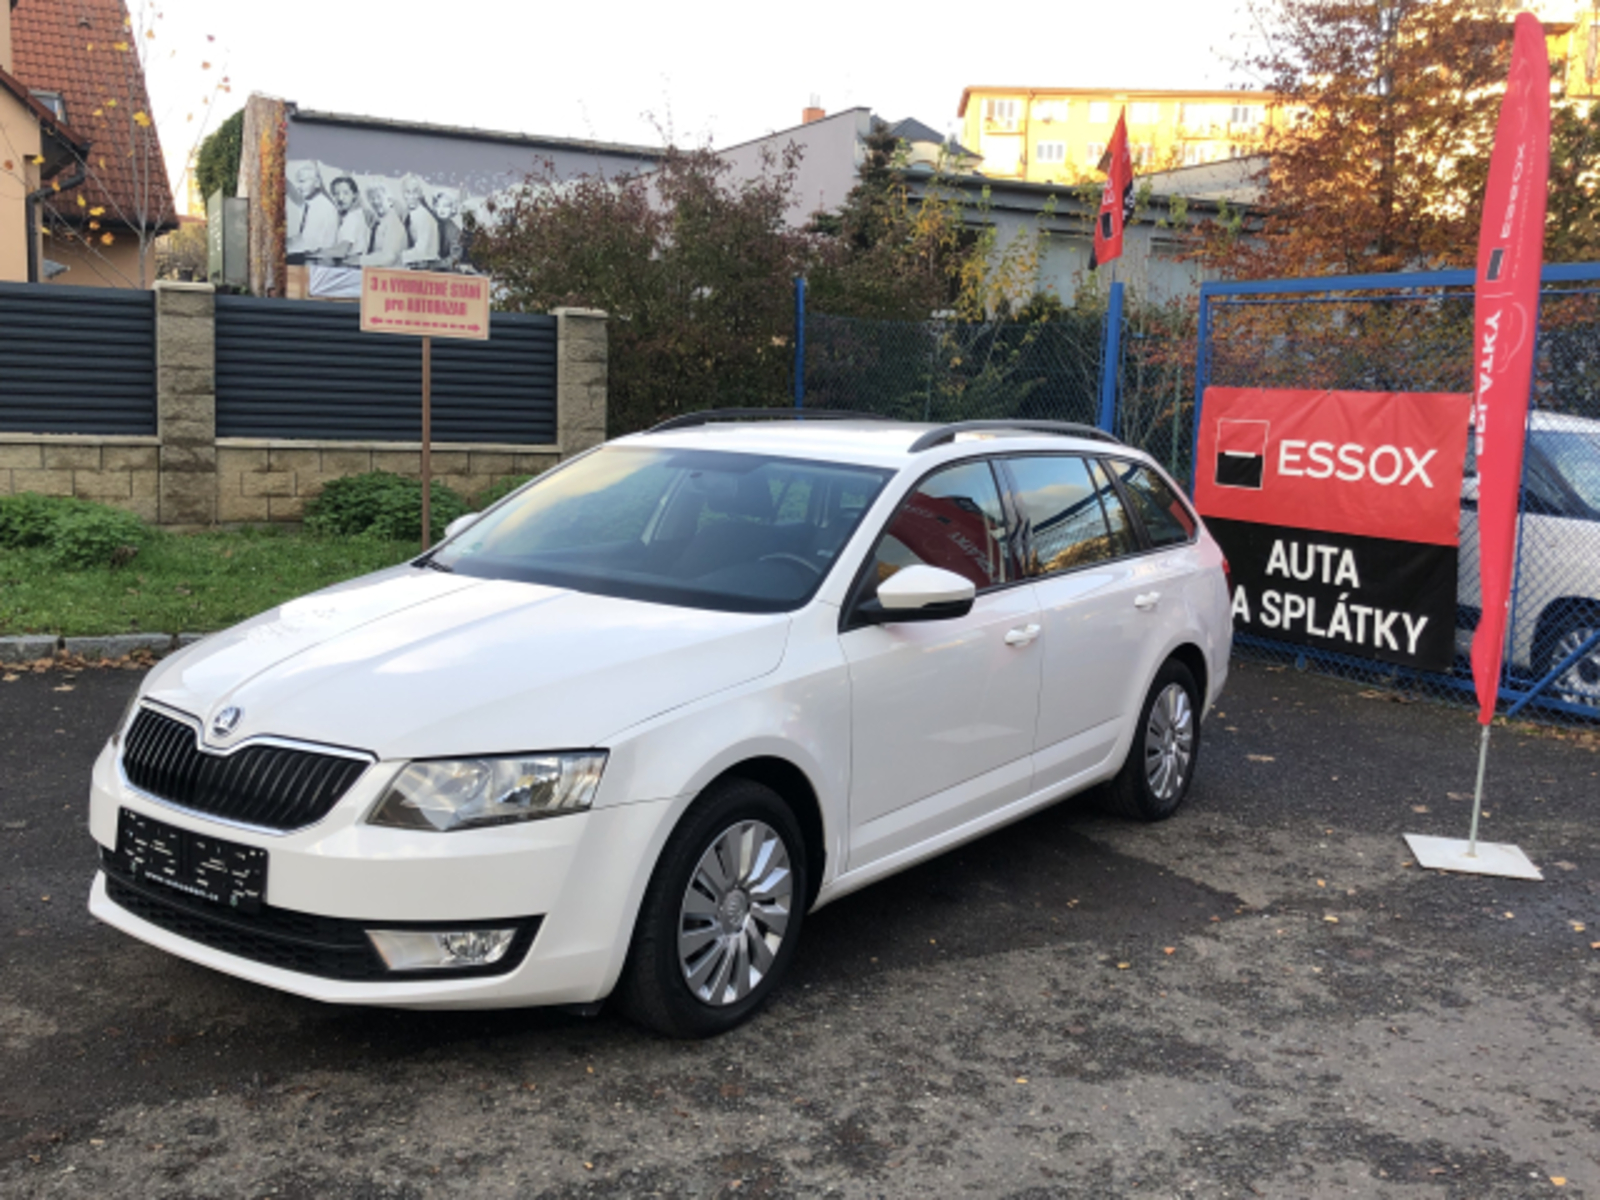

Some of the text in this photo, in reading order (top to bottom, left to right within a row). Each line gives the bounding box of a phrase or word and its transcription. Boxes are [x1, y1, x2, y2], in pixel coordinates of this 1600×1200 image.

[370, 276, 379, 291] 3
[385, 298, 404, 313] pro
[1277, 439, 1438, 488] ESSOX
[1265, 539, 1360, 589] AUTA
[1231, 584, 1429, 655] A SPLÁTKY
